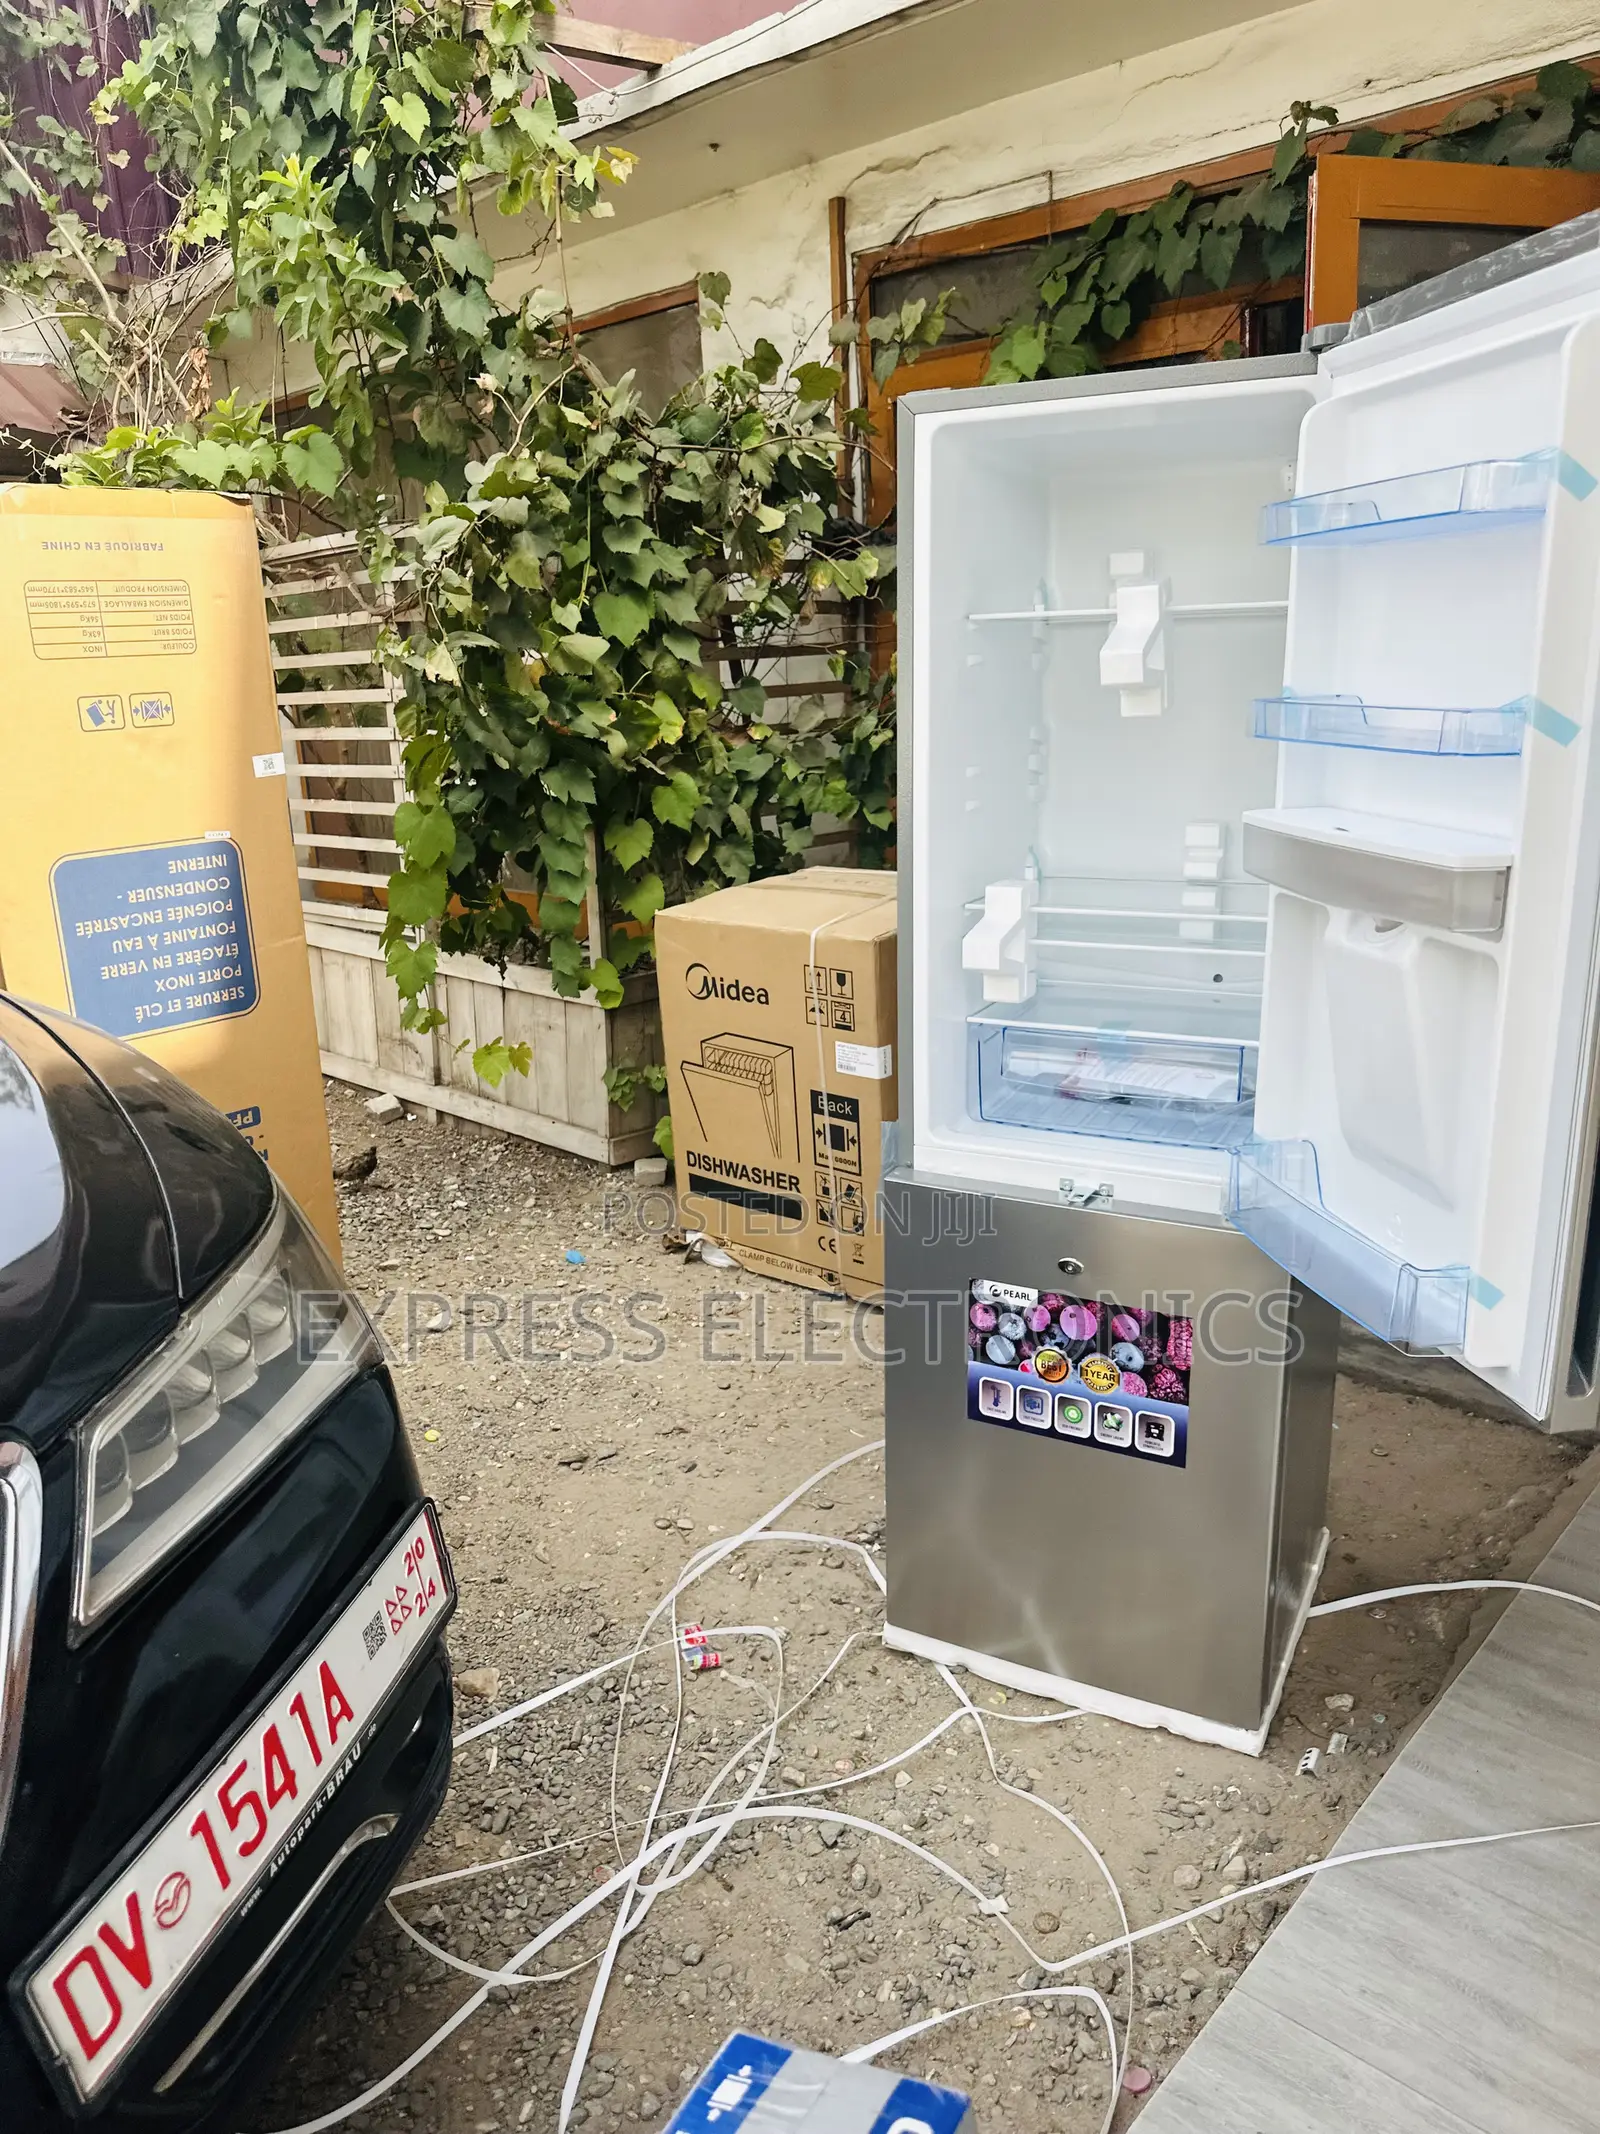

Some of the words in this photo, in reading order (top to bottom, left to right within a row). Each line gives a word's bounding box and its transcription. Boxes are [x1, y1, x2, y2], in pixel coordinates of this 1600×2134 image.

[42, 541, 81, 550] CHINE
[85, 542, 101, 550] EN
[149, 599, 189, 607] DIMENSION
[169, 613, 191, 621] POIDS
[82, 645, 103, 653] INOX
[168, 854, 228, 874] INTERNE
[127, 876, 231, 904] CONDENSUER
[167, 899, 233, 924] POIGNÉE
[75, 909, 164, 939] ENCASTRÉE
[163, 921, 237, 945] FONTAINE
[112, 936, 144, 954] EAU
[147, 933, 159, 951] À
[152, 955, 172, 970] EN
[176, 942, 240, 966] ÉTAGÈRE
[100, 958, 149, 980] VERRE
[198, 964, 242, 985] PORTE
[154, 975, 195, 993] INOX
[688, 966, 770, 1006] Midea
[167, 999, 182, 1013] ET
[185, 985, 246, 1008] SERRURE
[134, 1003, 163, 1024] CLÉ
[818, 1095, 853, 1116] Back
[686, 1150, 802, 1193] DISHWASHER
[738, 1249, 765, 1263] CLAMP
[766, 1256, 794, 1271] BELOW
[795, 1264, 813, 1276] LINE
[1003, 1289, 1032, 1302] PEARL
[1090, 1370, 1116, 1382] YEAR
[52, 1889, 153, 2062] DV
[189, 1660, 355, 1891] 1541A
